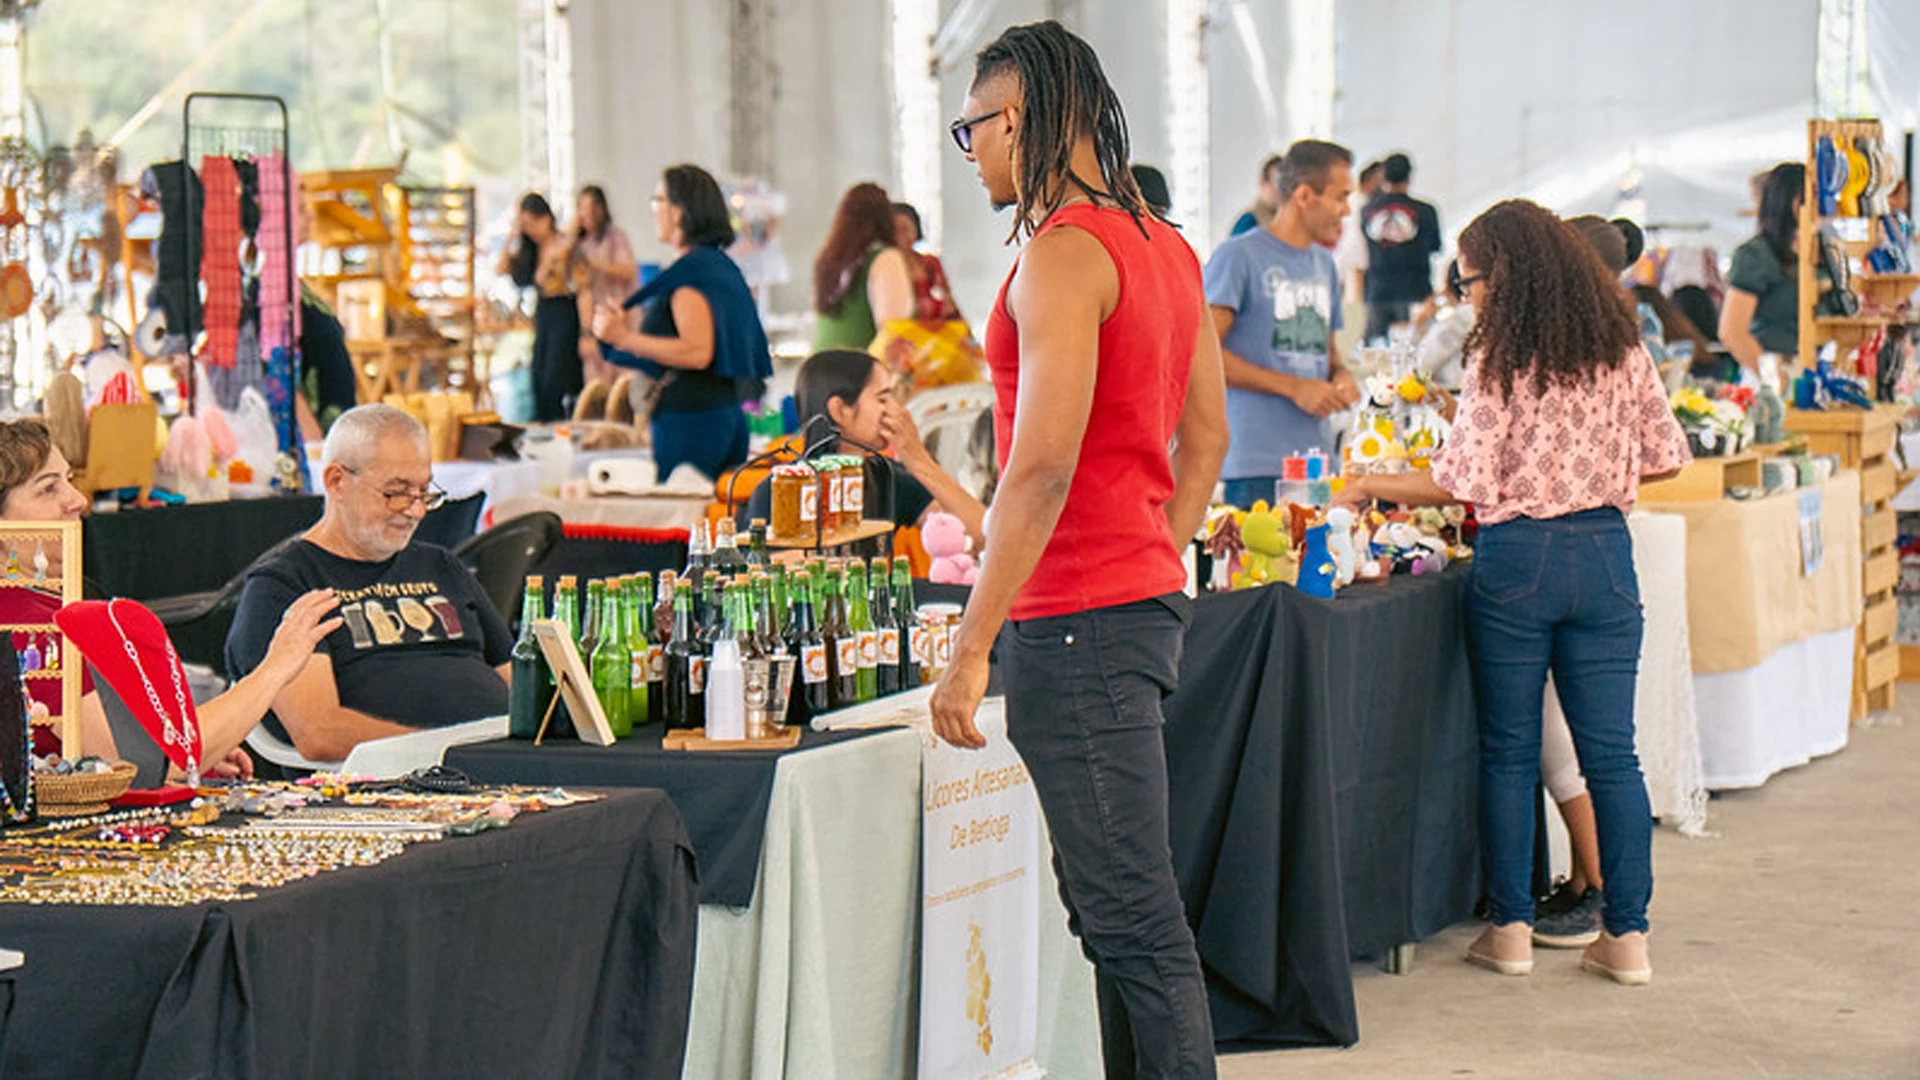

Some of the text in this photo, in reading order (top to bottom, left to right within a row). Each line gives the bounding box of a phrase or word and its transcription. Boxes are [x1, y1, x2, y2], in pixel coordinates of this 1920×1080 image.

[925, 777, 969, 812] Licores
[950, 813, 1010, 849] De Bertioga
